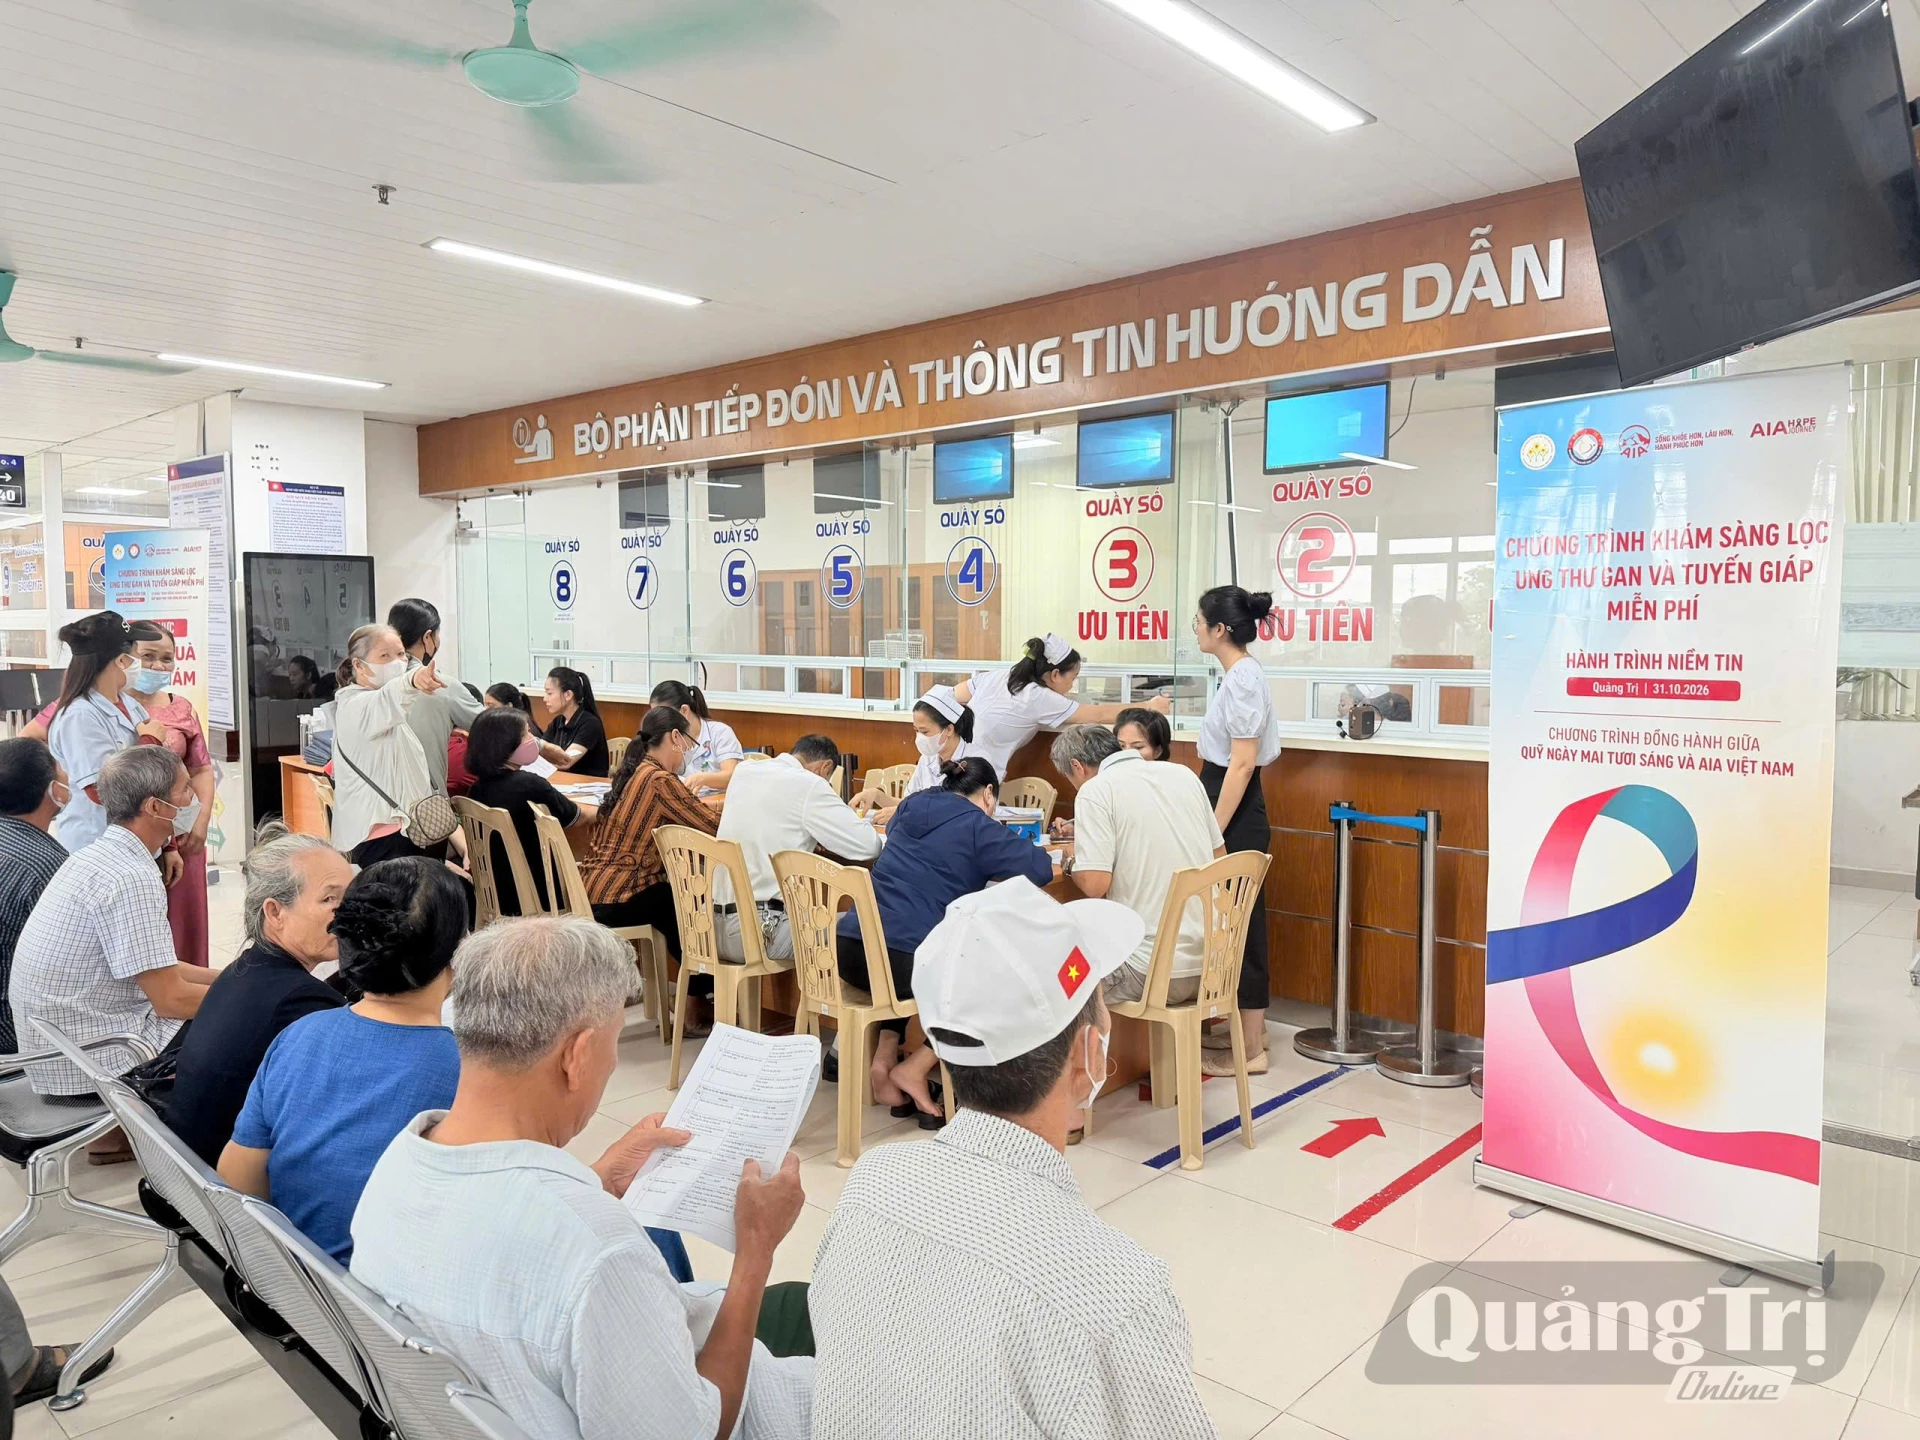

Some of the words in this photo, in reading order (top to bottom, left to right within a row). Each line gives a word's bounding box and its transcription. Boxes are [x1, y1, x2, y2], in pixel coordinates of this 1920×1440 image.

[573, 411, 611, 459] BỘ
[613, 401, 692, 451] PHẬN
[694, 383, 763, 437] TIẾP
[766, 375, 842, 428] ĐÓN
[847, 360, 904, 414] VÀ
[908, 340, 1062, 404] THÔNG
[1072, 317, 1157, 377] TIN
[1166, 272, 1389, 362] HƯỚNG
[1402, 224, 1566, 323] DẪN
[1750, 421, 1787, 438] AIA
[1620, 447, 1648, 458] AIA
[1273, 473, 1334, 502] QUẦY
[1339, 467, 1373, 497] SỐ
[940, 506, 980, 528] QUẦY
[984, 502, 1005, 525] SỐ
[1086, 491, 1135, 517] QUẦY
[1138, 486, 1164, 513] SỐ
[621, 531, 646, 549] QUẦY
[648, 529, 662, 548] SỐ
[713, 525, 742, 544] QUẦY
[744, 523, 759, 542] SỐ
[815, 516, 850, 537] QUẦY
[852, 514, 871, 535] SỐ
[1585, 528, 1644, 554] TRÌNH
[1652, 523, 1712, 550] KHÁM
[1719, 520, 1779, 548] SÀNG
[1787, 520, 1829, 550] LỌC
[544, 537, 566, 554] QUẦY
[568, 537, 580, 553] SỐ
[1297, 527, 1335, 583] 2
[156, 568, 171, 576] KHÁM
[727, 560, 747, 598] 6
[833, 555, 853, 596] 5
[958, 548, 984, 593] 4
[1109, 539, 1138, 589] 3
[1559, 565, 1599, 588] THƯ
[1602, 565, 1642, 588] GAN
[1649, 560, 1675, 586] VÀ
[1682, 554, 1752, 585] TUYẾN
[1759, 554, 1814, 583] GIÁP
[556, 569, 571, 602] 8
[634, 565, 650, 600] 7
[1305, 600, 1373, 642] TIÊN
[1607, 592, 1657, 621] MIỄN
[1664, 594, 1700, 621] PHÍ
[1078, 609, 1111, 641] ƯU
[1116, 604, 1168, 641] TIÊN
[175, 642, 196, 661] UÀ
[1566, 649, 1609, 670] HÀNH
[1614, 649, 1662, 670] TRÌNH
[1667, 648, 1710, 671] NIỀM
[1714, 653, 1743, 672] TIN
[172, 667, 196, 686] ÁM
[1652, 683, 1709, 696] 31.10.2026
[1548, 726, 1598, 743] CHƯƠNG
[1601, 727, 1640, 745] TRÌNH
[1644, 727, 1679, 747] ĐỒNG
[1683, 732, 1722, 749] HÀNH
[1727, 734, 1760, 752] GIỮA
[1520, 743, 1545, 760] QUỸ
[1547, 744, 1578, 762] NGÀY
[1580, 749, 1604, 764] MAI
[1607, 750, 1636, 766] TƯƠI
[1639, 749, 1674, 769] SÁNG
[1677, 752, 1695, 770] VÀ
[1698, 756, 1723, 771] AIA
[1727, 754, 1758, 776] VIỆT
[1761, 759, 1795, 777] NAM
